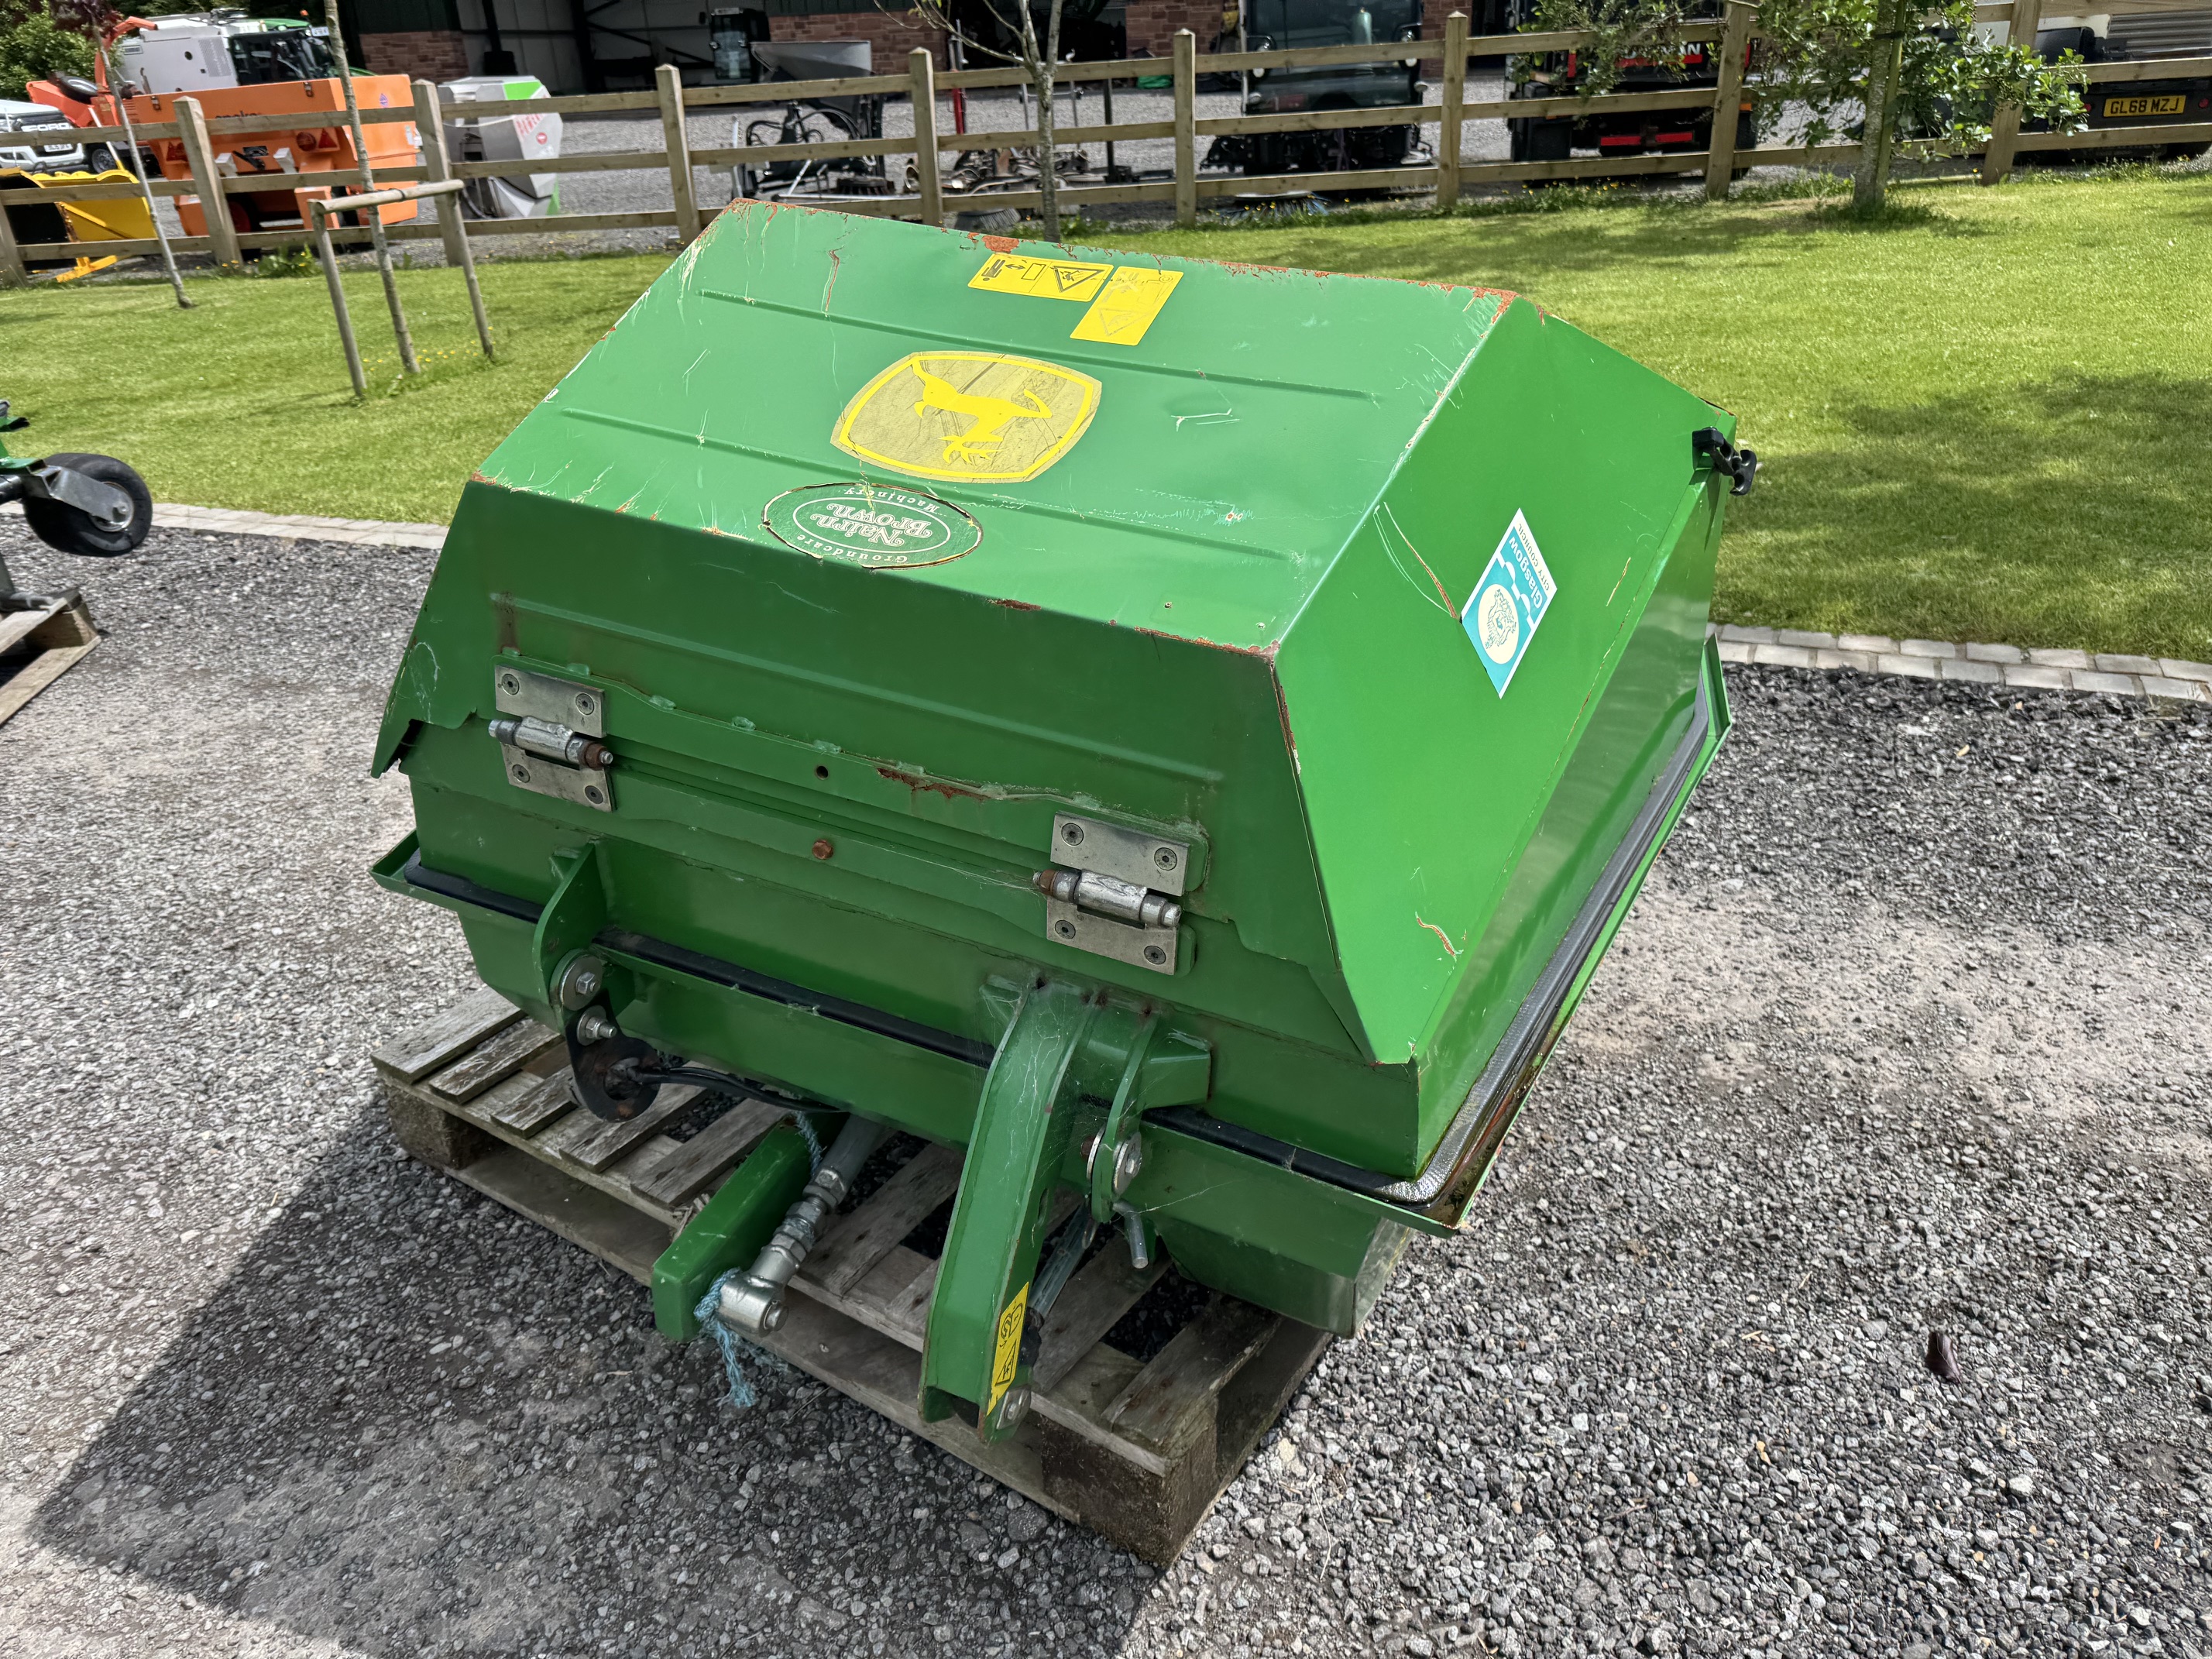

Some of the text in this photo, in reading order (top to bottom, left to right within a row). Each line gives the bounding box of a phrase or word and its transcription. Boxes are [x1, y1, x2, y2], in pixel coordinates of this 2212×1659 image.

[2110, 98, 2179, 115] GL68 MZJ
[843, 487, 940, 514] Machinery
[809, 513, 905, 547] Nairn
[825, 503, 933, 539] Brown
[796, 533, 908, 564] Groundcare
[1517, 523, 1550, 591] CITY COUNCIL
[1508, 536, 1543, 609] Glasgow
